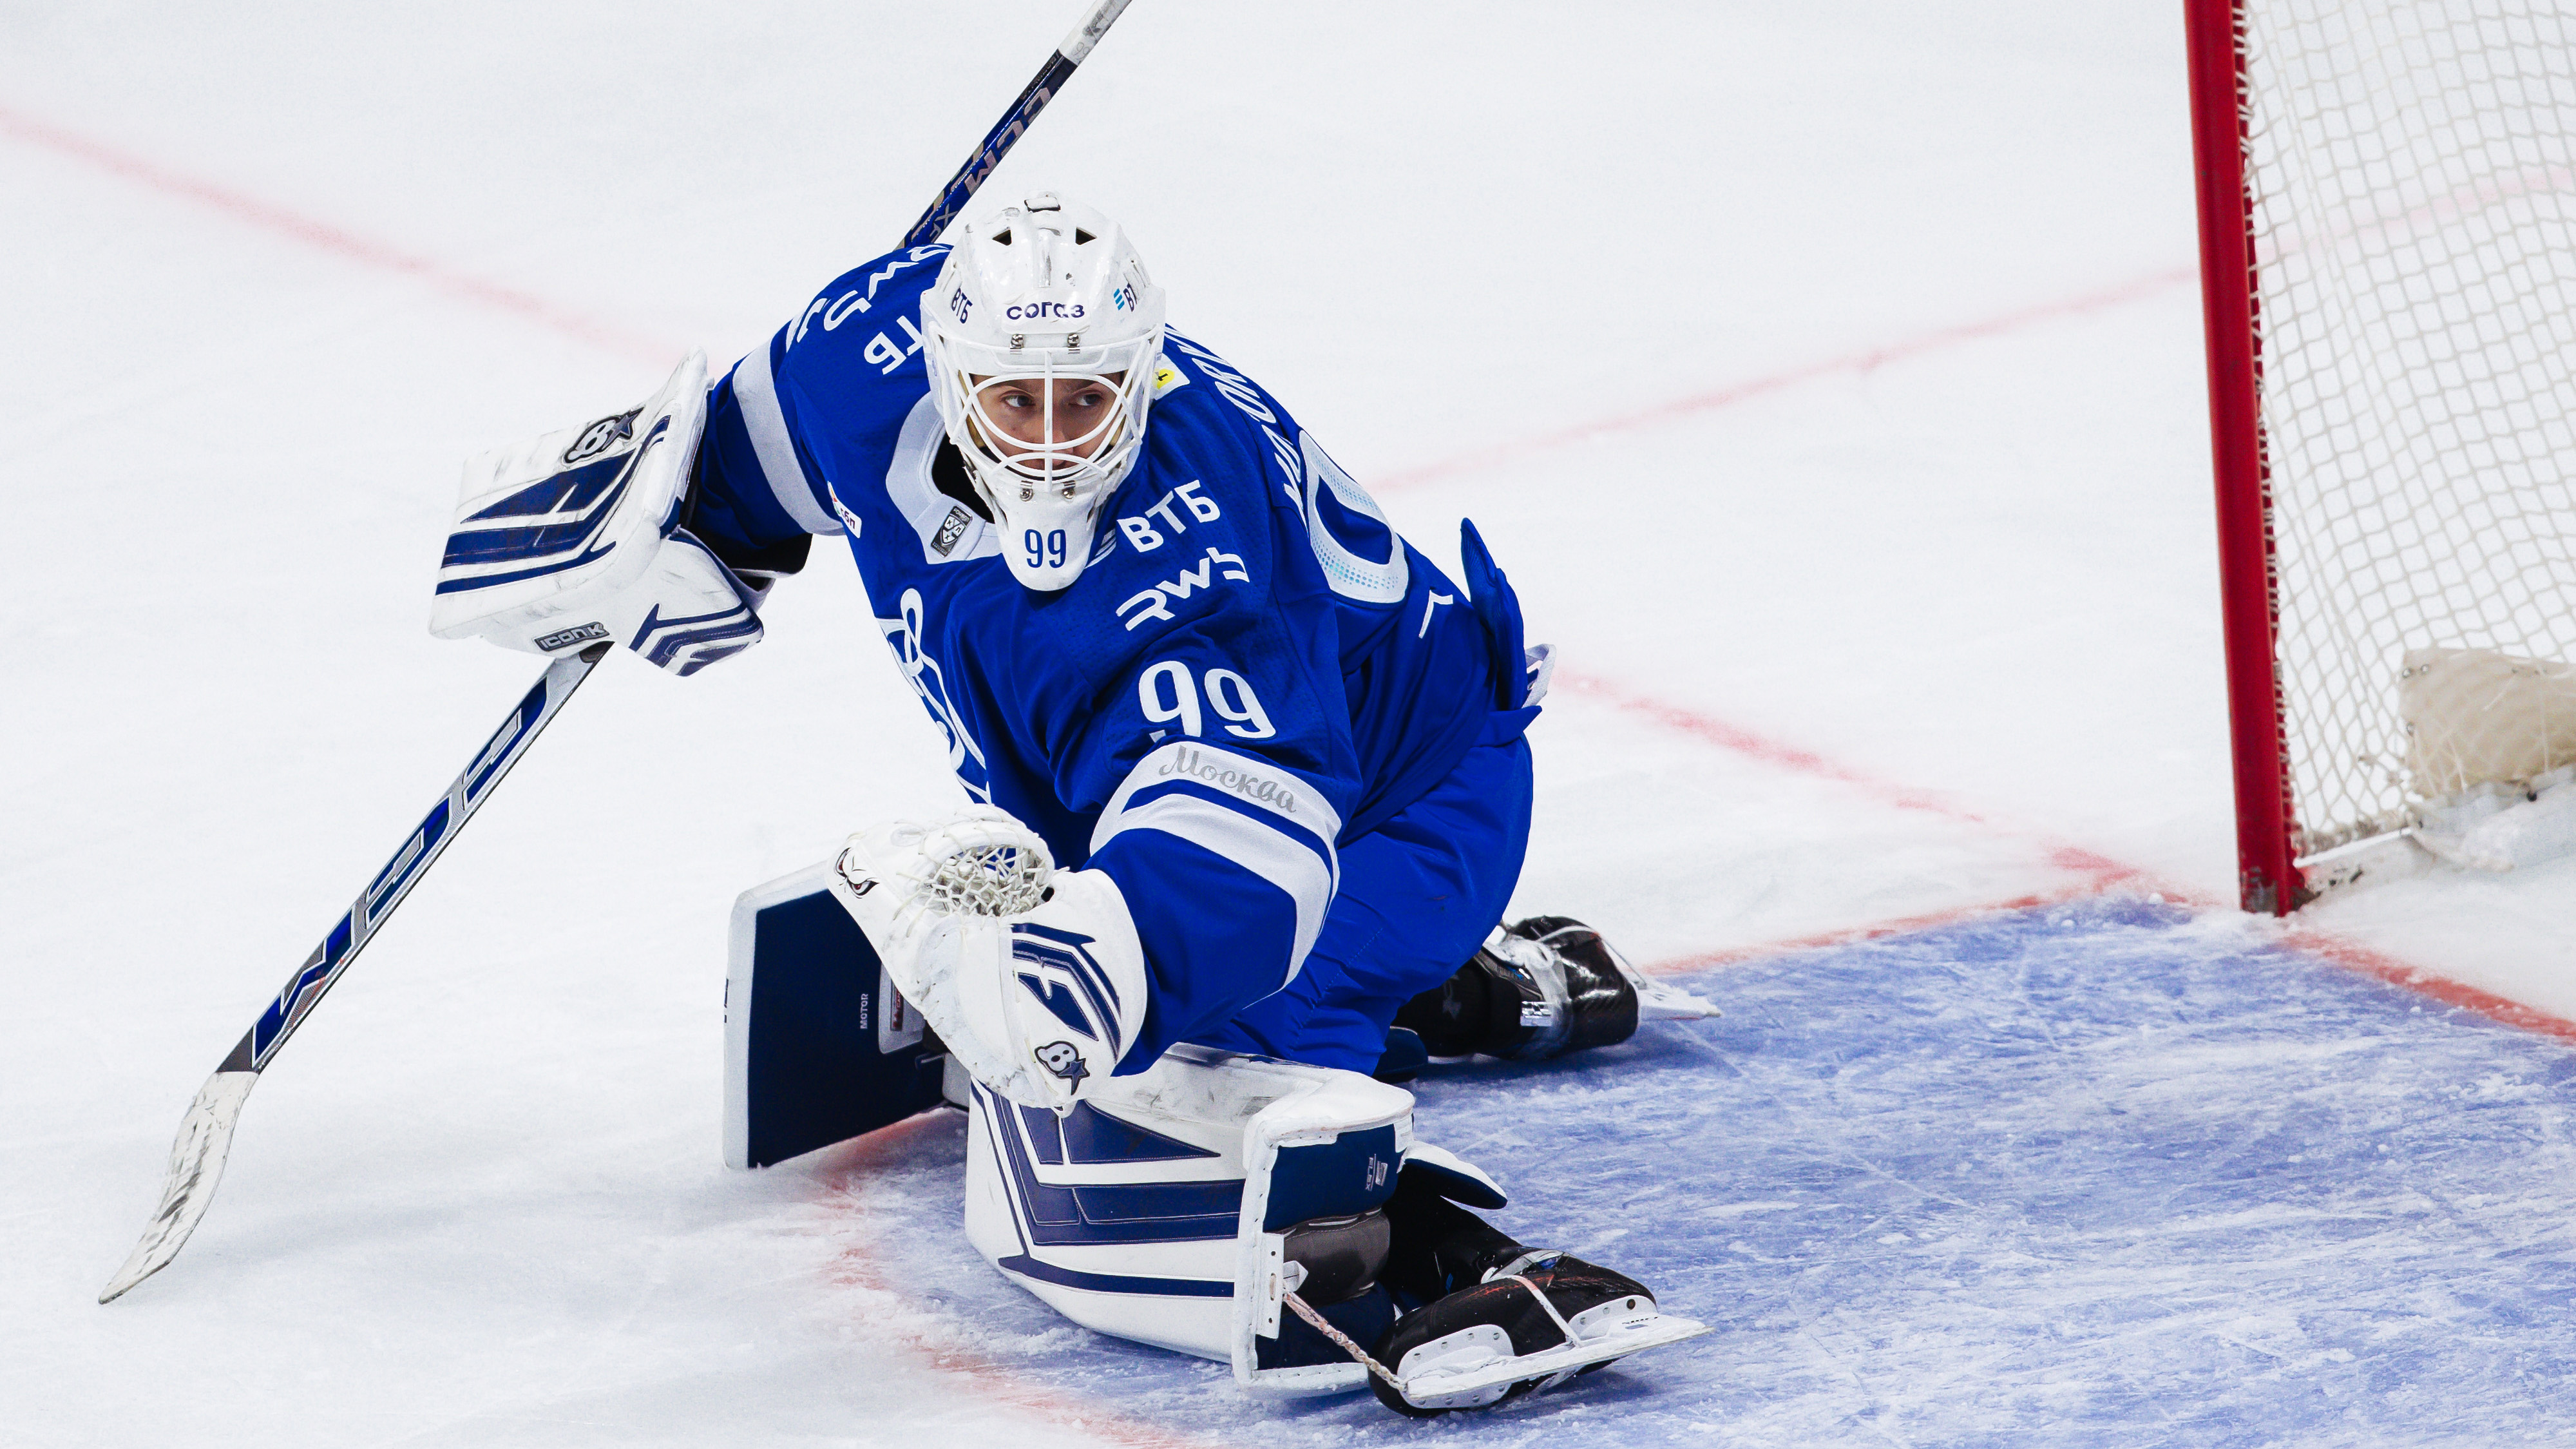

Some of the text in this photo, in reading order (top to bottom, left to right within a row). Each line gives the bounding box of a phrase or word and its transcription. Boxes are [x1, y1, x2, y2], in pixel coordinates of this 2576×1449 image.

[964, 87, 1051, 195] CCM
[951, 287, 973, 324] ВТБ
[864, 314, 931, 375] ТБ
[1024, 528, 1067, 568] 99
[1117, 479, 1221, 553] ВТБ
[1138, 660, 1277, 743] 99
[1159, 744, 1297, 814] Москва
[252, 673, 548, 1070] CCM
[859, 993, 869, 1030] MOTOR
